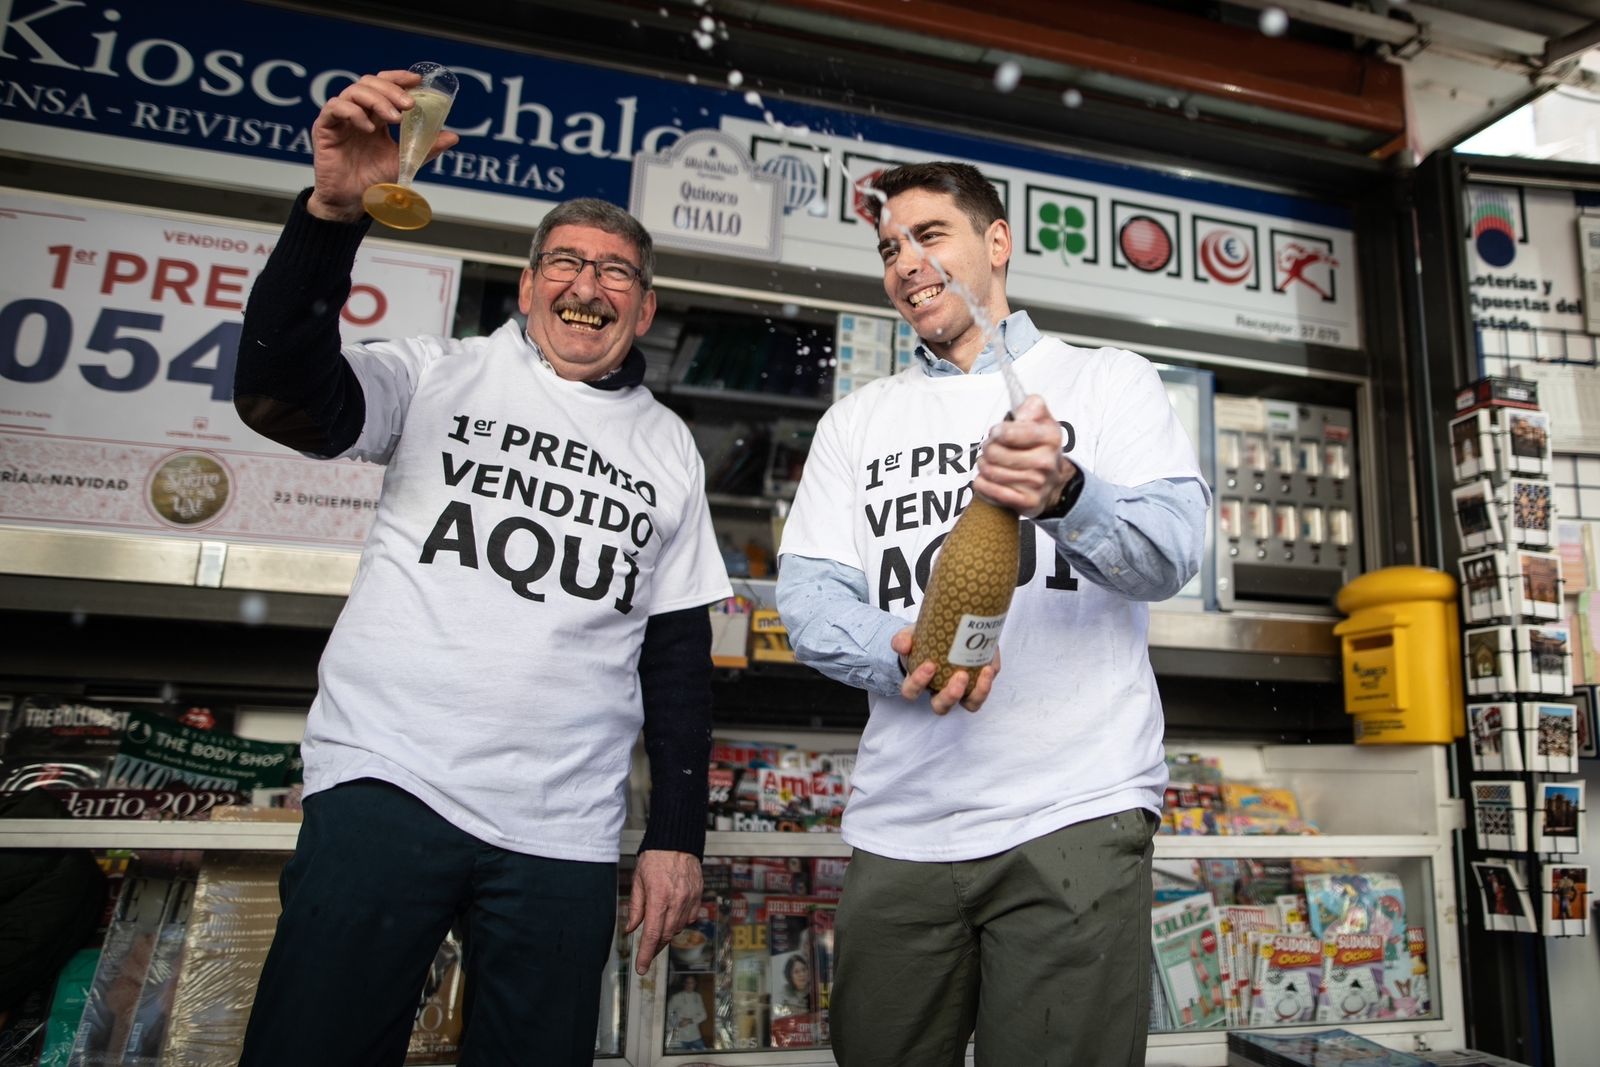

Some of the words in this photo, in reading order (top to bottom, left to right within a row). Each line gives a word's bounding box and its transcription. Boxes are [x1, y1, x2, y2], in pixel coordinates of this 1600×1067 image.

[0, 79, 97, 121] NSA
[130, 100, 314, 155] REVISTA
[430, 150, 566, 193] TERÍAS
[680, 180, 739, 207] Quiosco
[673, 203, 742, 237] CHALO
[163, 229, 248, 253] VENDIDO
[100, 249, 389, 328] PREO
[1542, 280, 1553, 296] y
[1472, 315, 1531, 331] stado
[0, 297, 243, 403] 054
[448, 414, 497, 446] 1er
[500, 423, 657, 508] PREMIO
[865, 451, 903, 492] 1er
[50, 474, 129, 492] NAVIDAD
[442, 451, 654, 549] VENDIDO
[864, 480, 976, 538] VEND
[418, 500, 640, 615] AQUÍ
[156, 730, 188, 752] THE
[191, 741, 238, 764] BODY
[239, 750, 285, 769] SHOP
